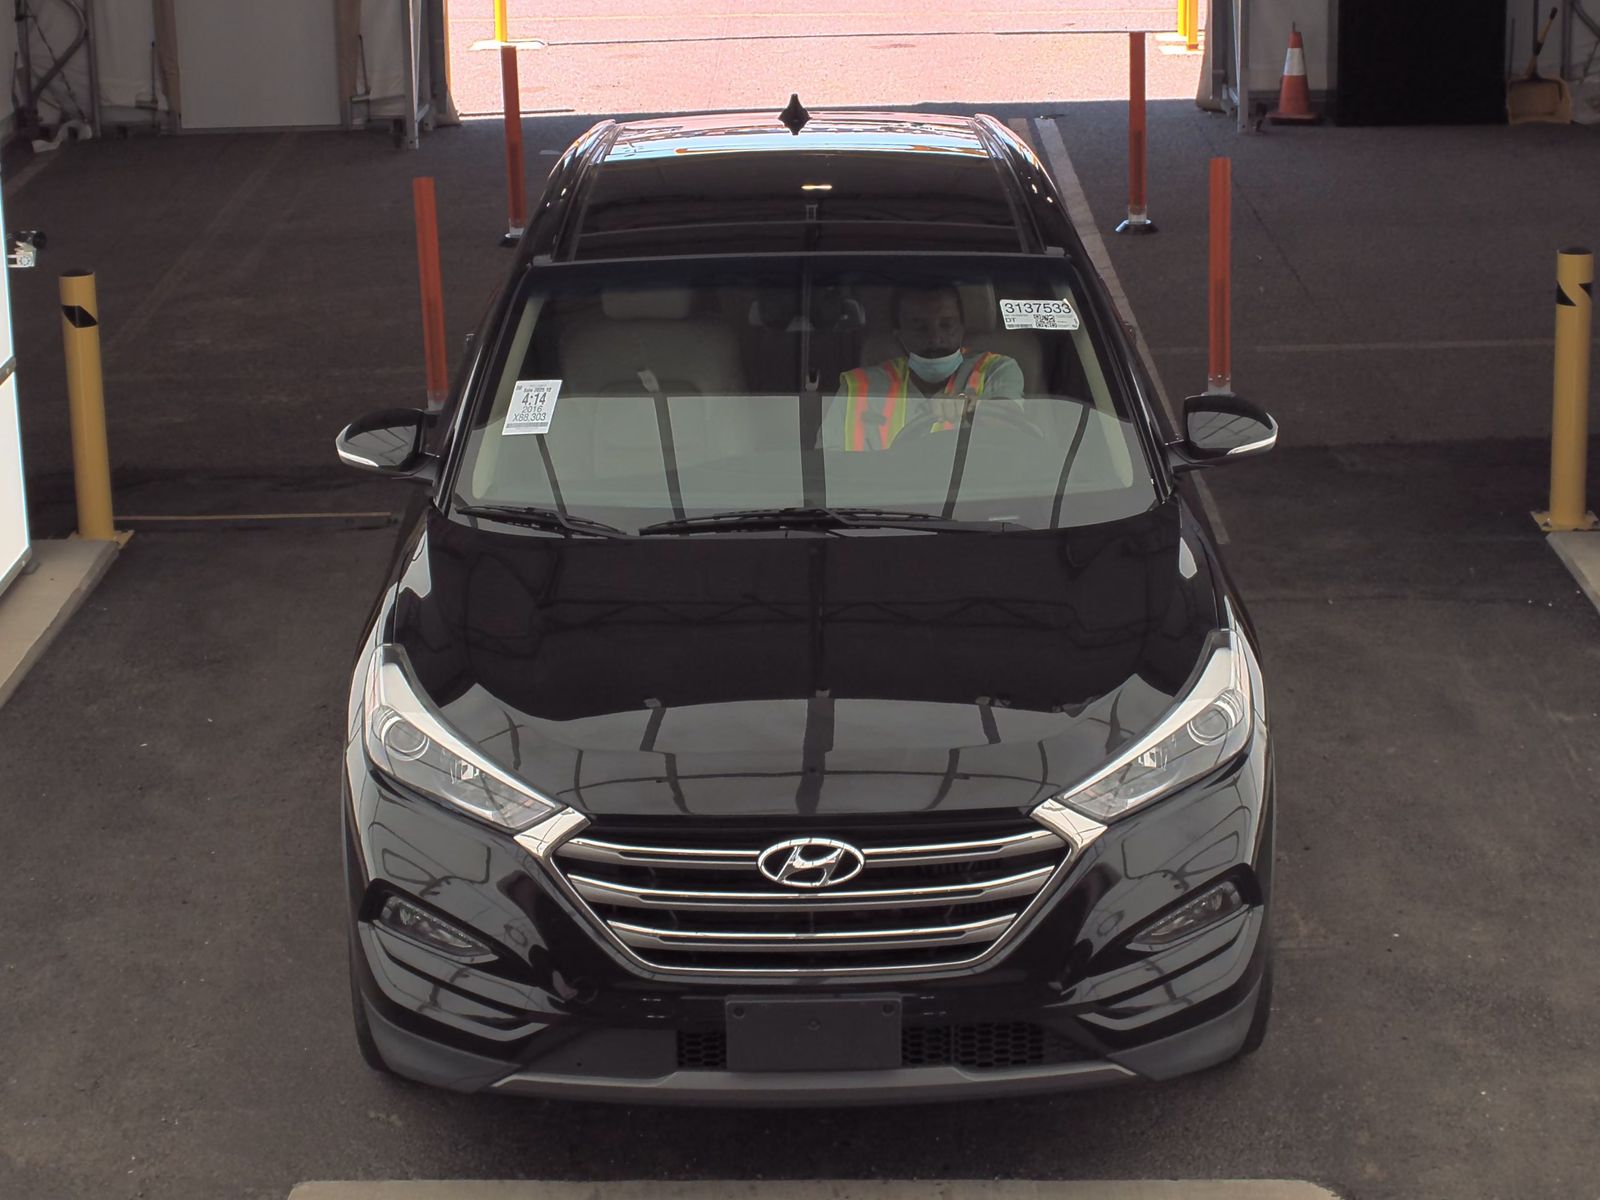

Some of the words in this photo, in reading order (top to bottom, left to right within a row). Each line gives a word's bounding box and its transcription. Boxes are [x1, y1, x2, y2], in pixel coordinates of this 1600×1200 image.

[1004, 302, 1072, 314] 3137533
[522, 392, 547, 405] 4:14
[521, 405, 543, 413] 2016
